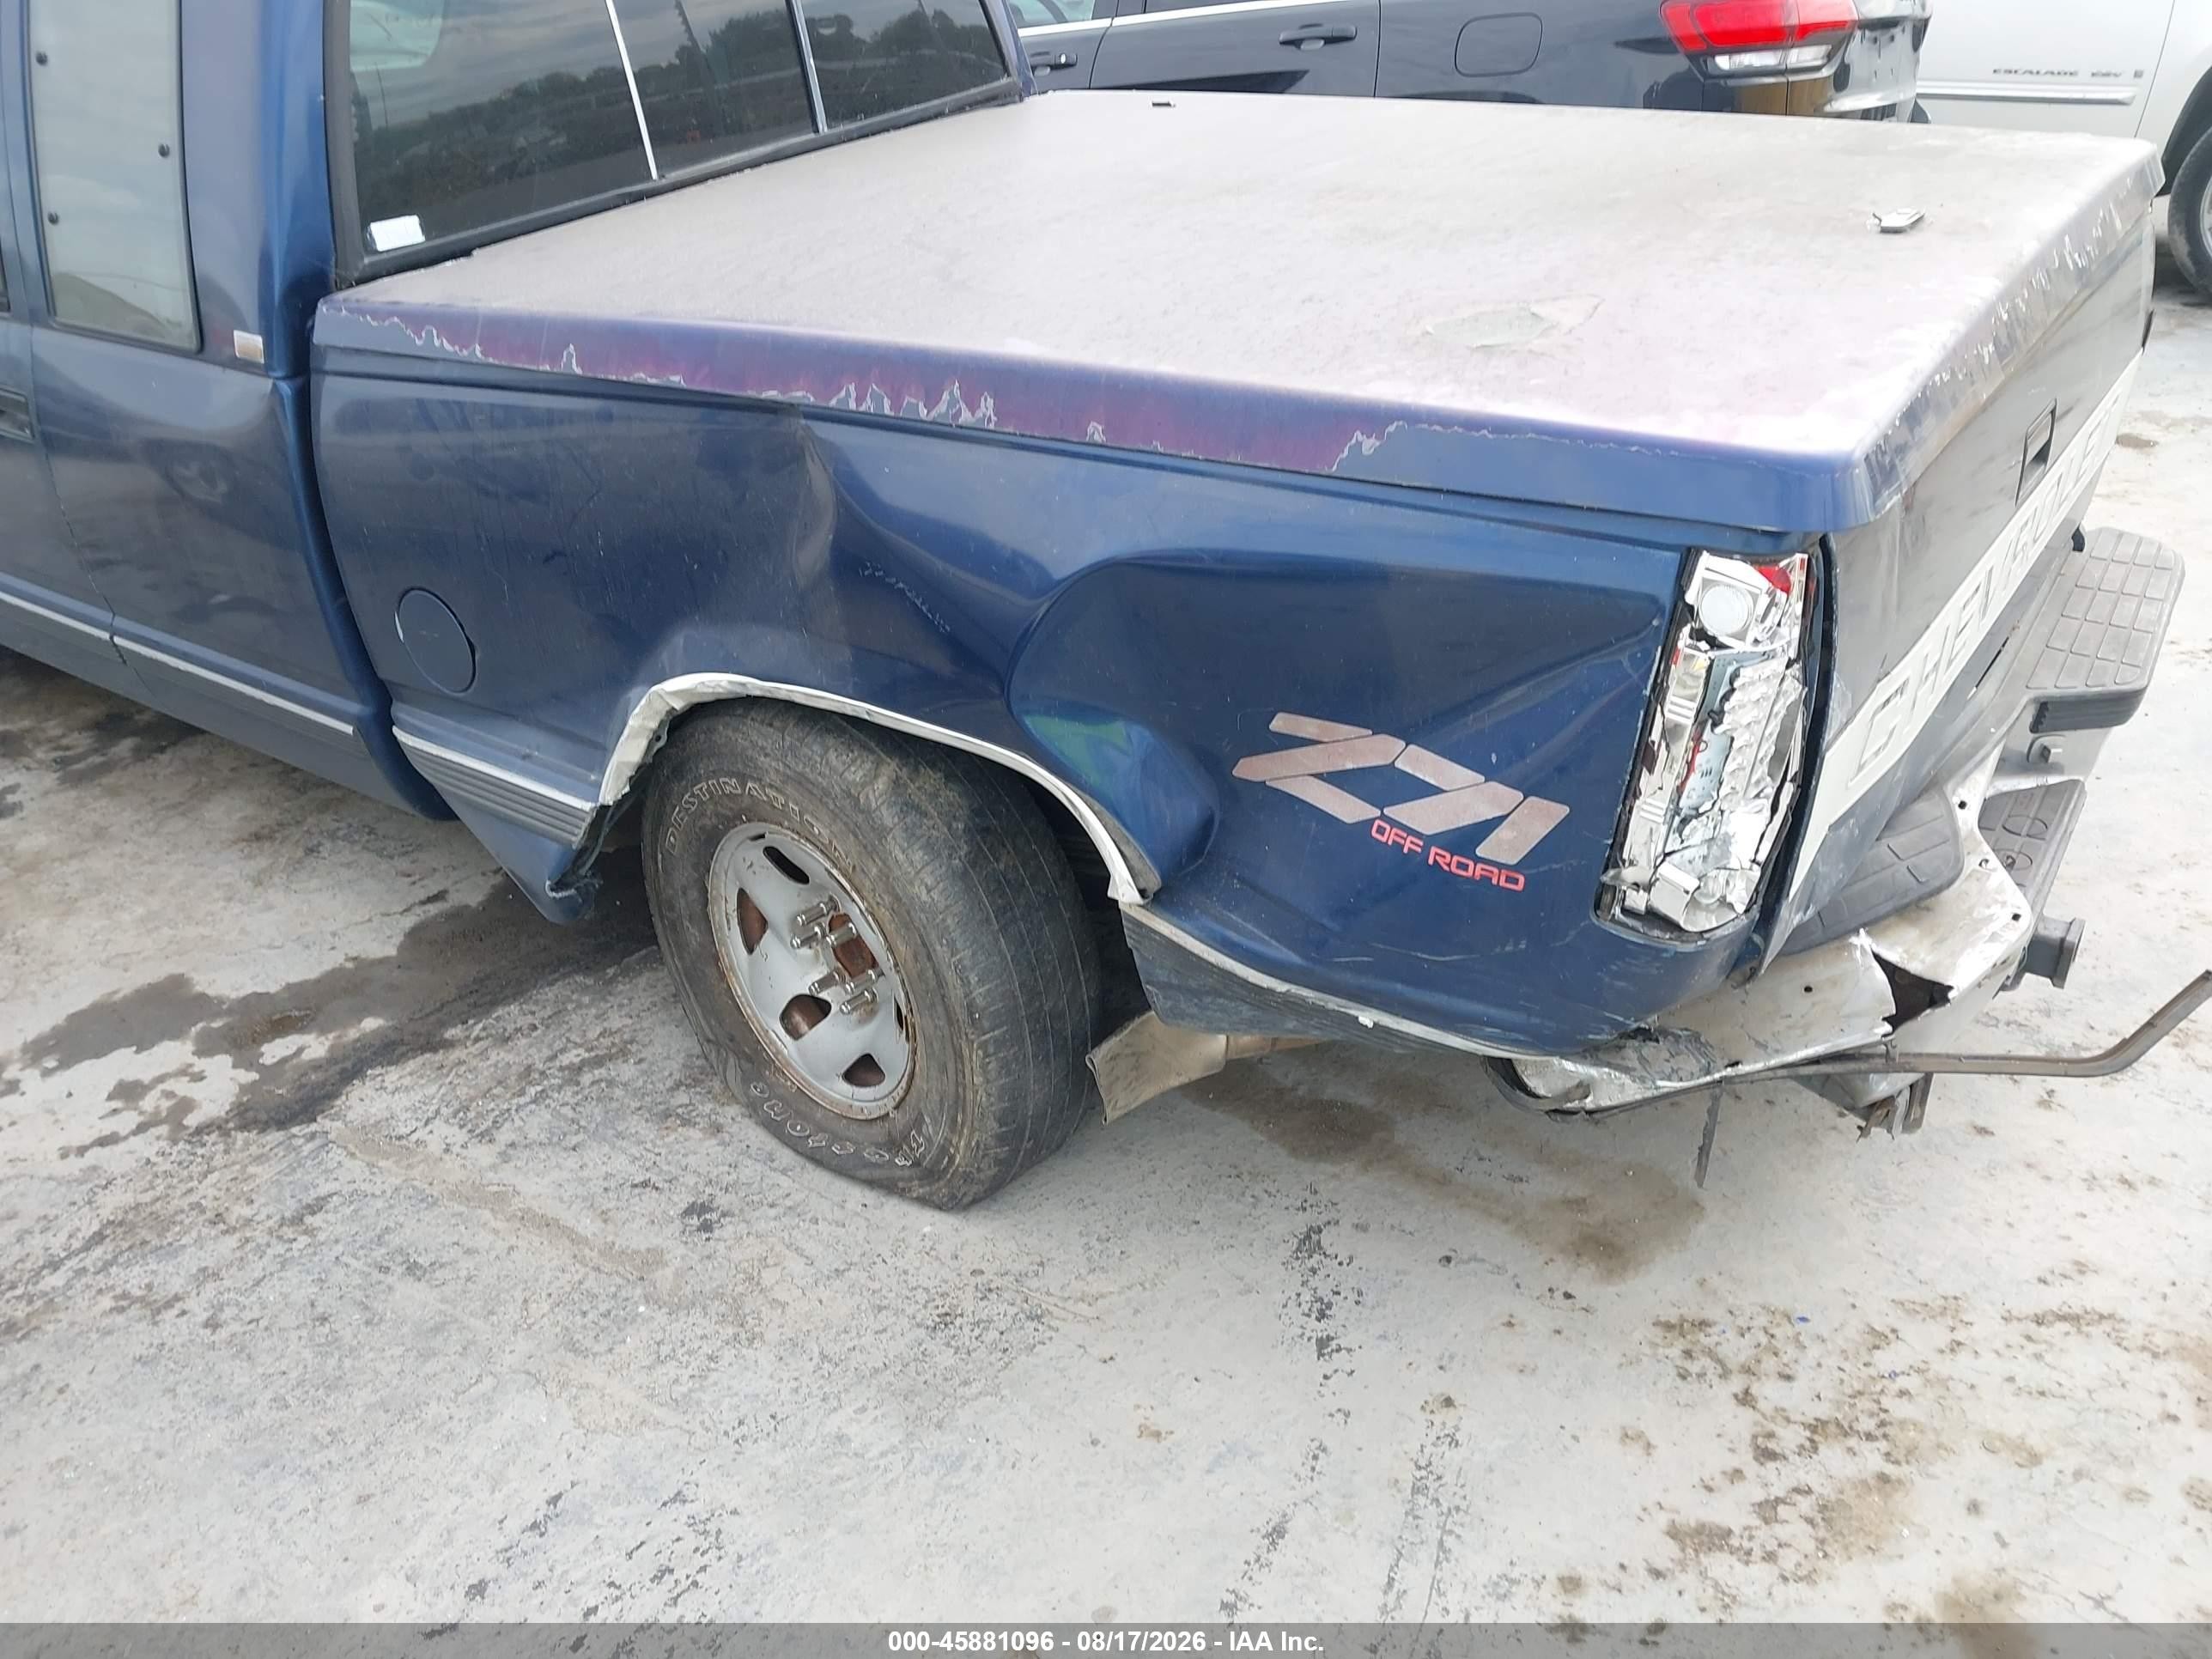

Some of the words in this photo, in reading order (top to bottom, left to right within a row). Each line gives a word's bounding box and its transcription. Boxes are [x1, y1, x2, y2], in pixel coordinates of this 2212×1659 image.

[1991, 67, 2080, 78] ESCALADE
[1849, 393, 2121, 788] CHEVROLET
[665, 776, 853, 874] DESTINATION
[1231, 711, 1571, 866] Z71
[1370, 818, 1425, 855] OFF
[1426, 846, 1526, 892] ROAD
